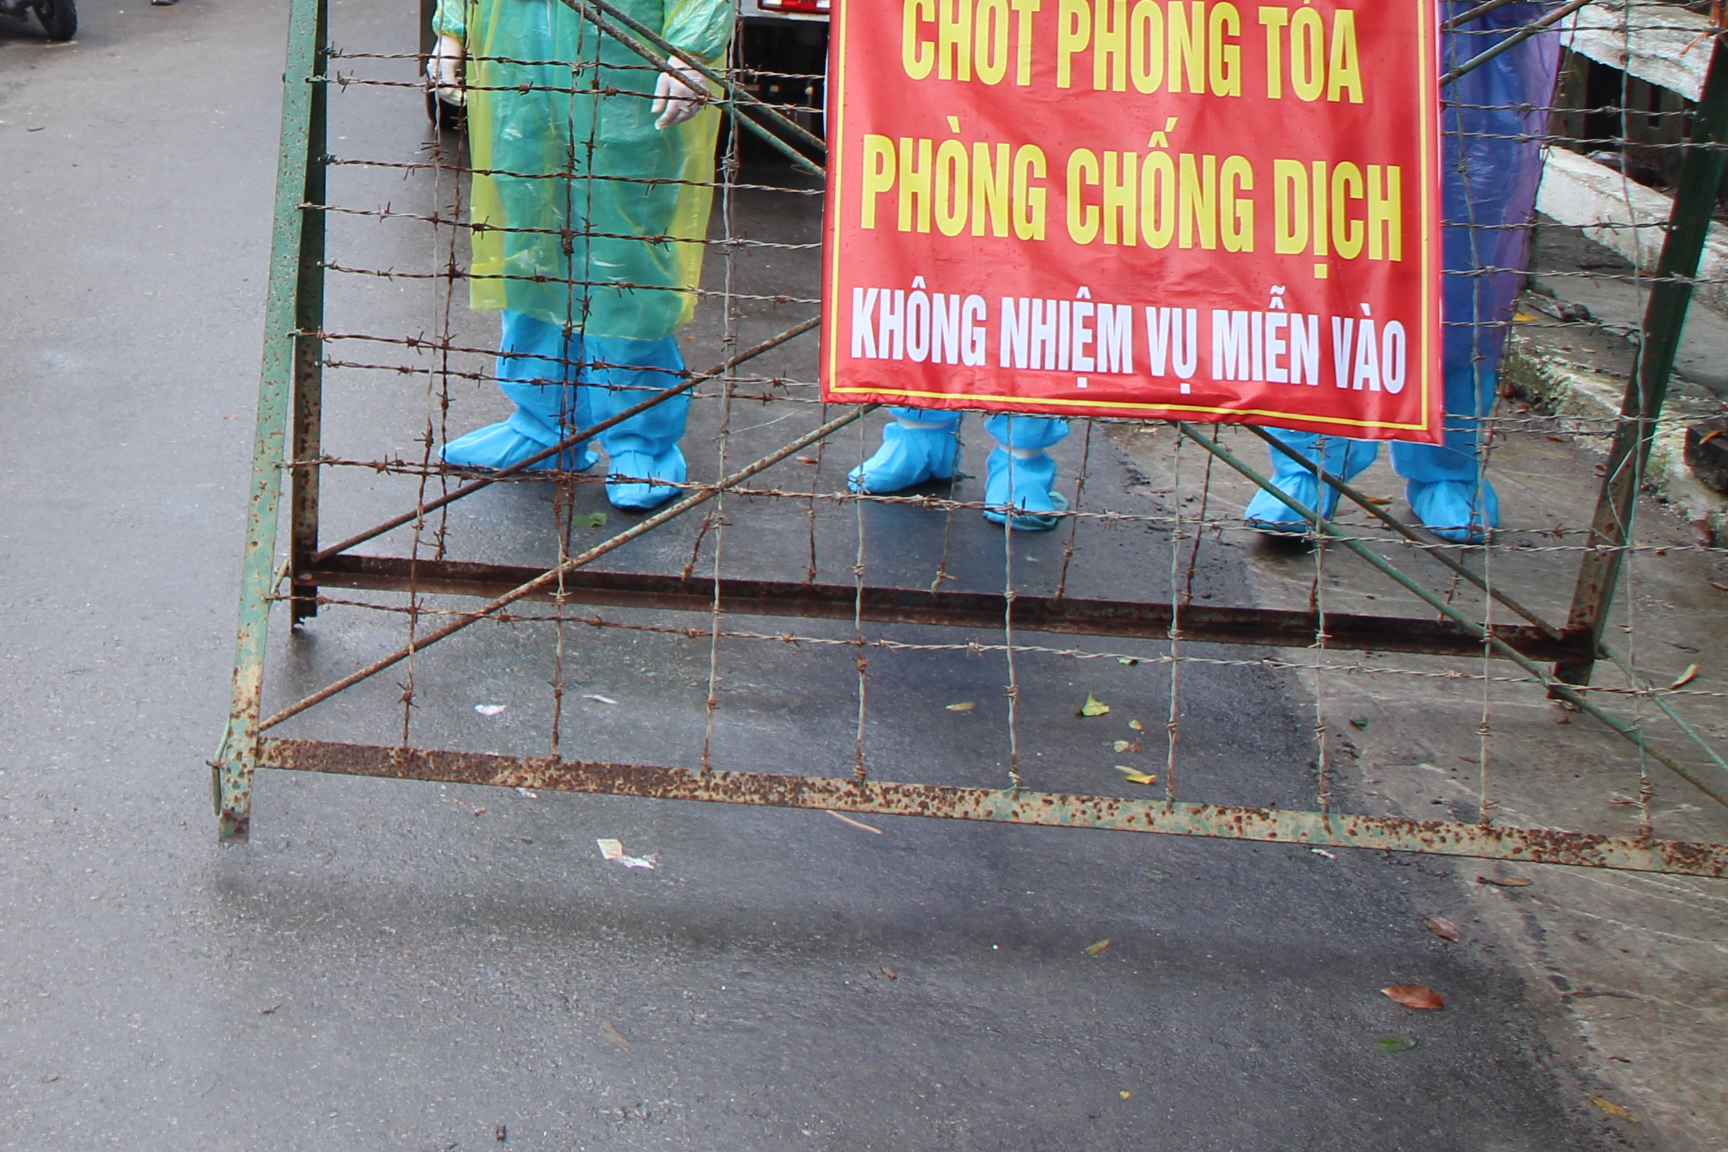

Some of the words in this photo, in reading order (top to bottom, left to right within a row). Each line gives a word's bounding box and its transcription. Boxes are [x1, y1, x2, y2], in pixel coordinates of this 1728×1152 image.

[860, 115, 1048, 242] PHÒNG
[1066, 116, 1255, 253] CHỐNG
[1273, 157, 1403, 280] DỊCH
[851, 275, 987, 368] KHÔNG
[1000, 285, 1134, 389] NHIỆM
[1145, 305, 1198, 395] VỤ
[1211, 284, 1320, 387] MIỄN
[1331, 301, 1407, 395] VÀO
